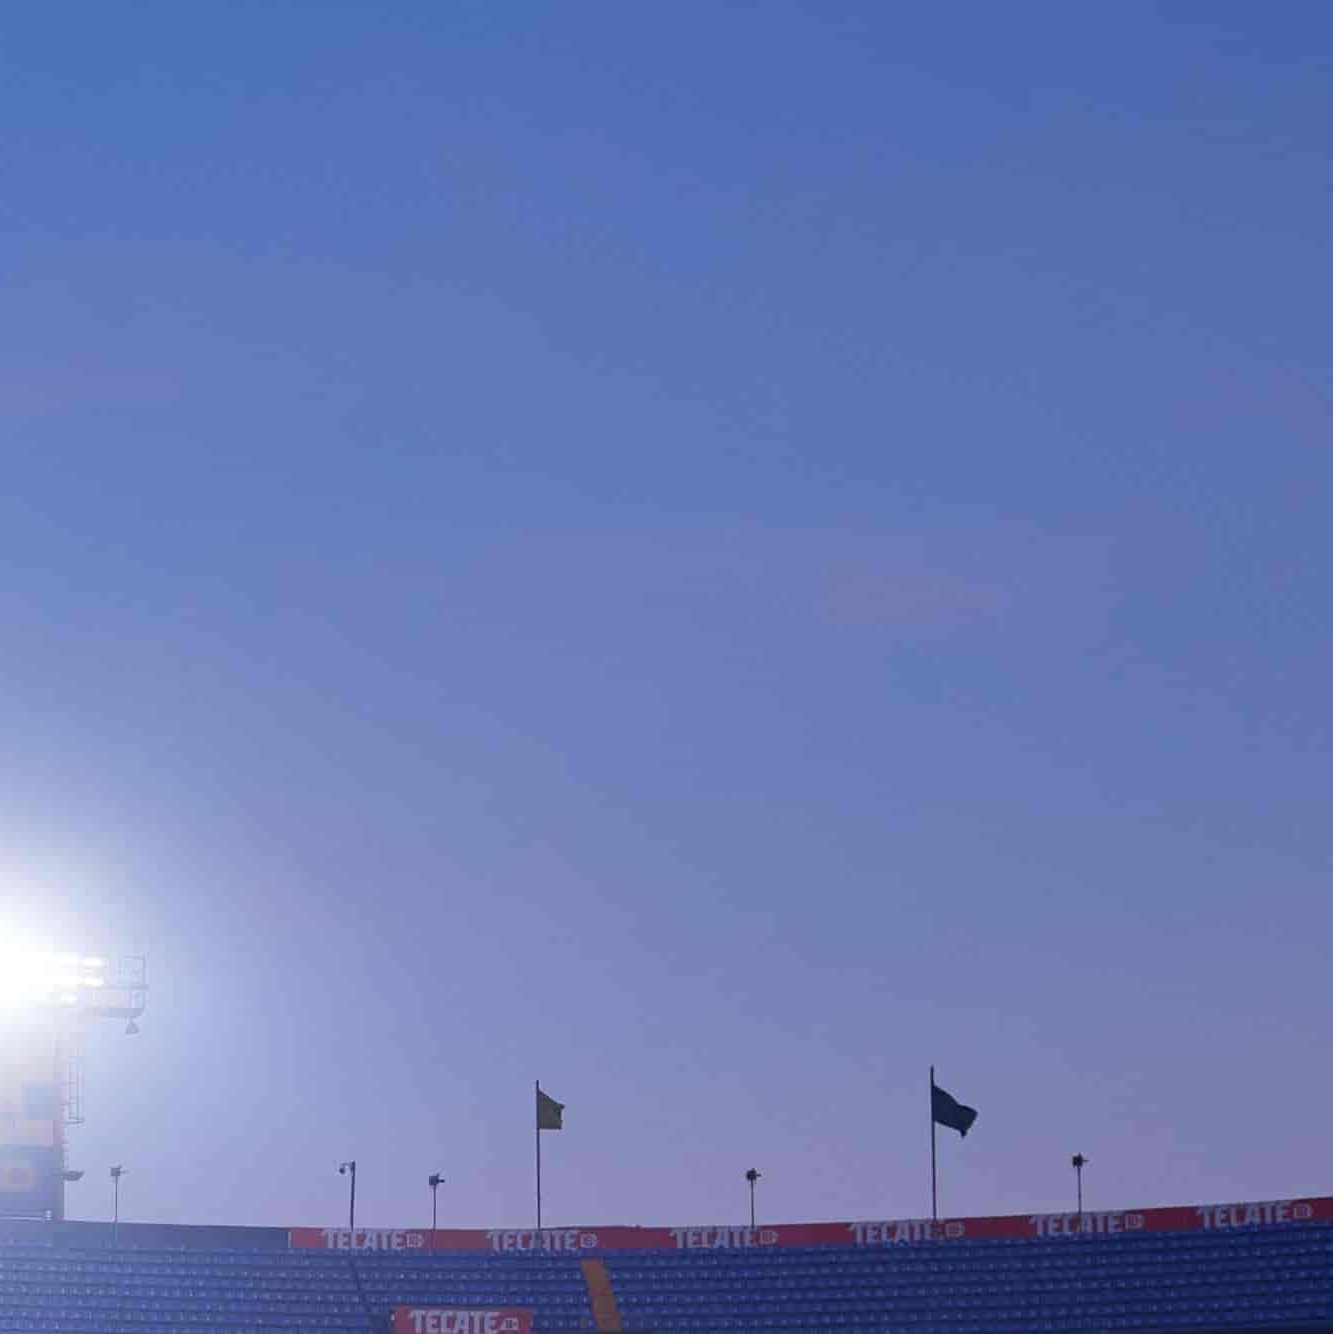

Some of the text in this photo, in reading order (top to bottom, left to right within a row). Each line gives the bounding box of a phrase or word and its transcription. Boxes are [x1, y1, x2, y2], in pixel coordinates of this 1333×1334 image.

[1031, 1215, 1124, 1236] TECATE
[1197, 1202, 1294, 1228] TECATE
[321, 1229, 406, 1250] TECATE
